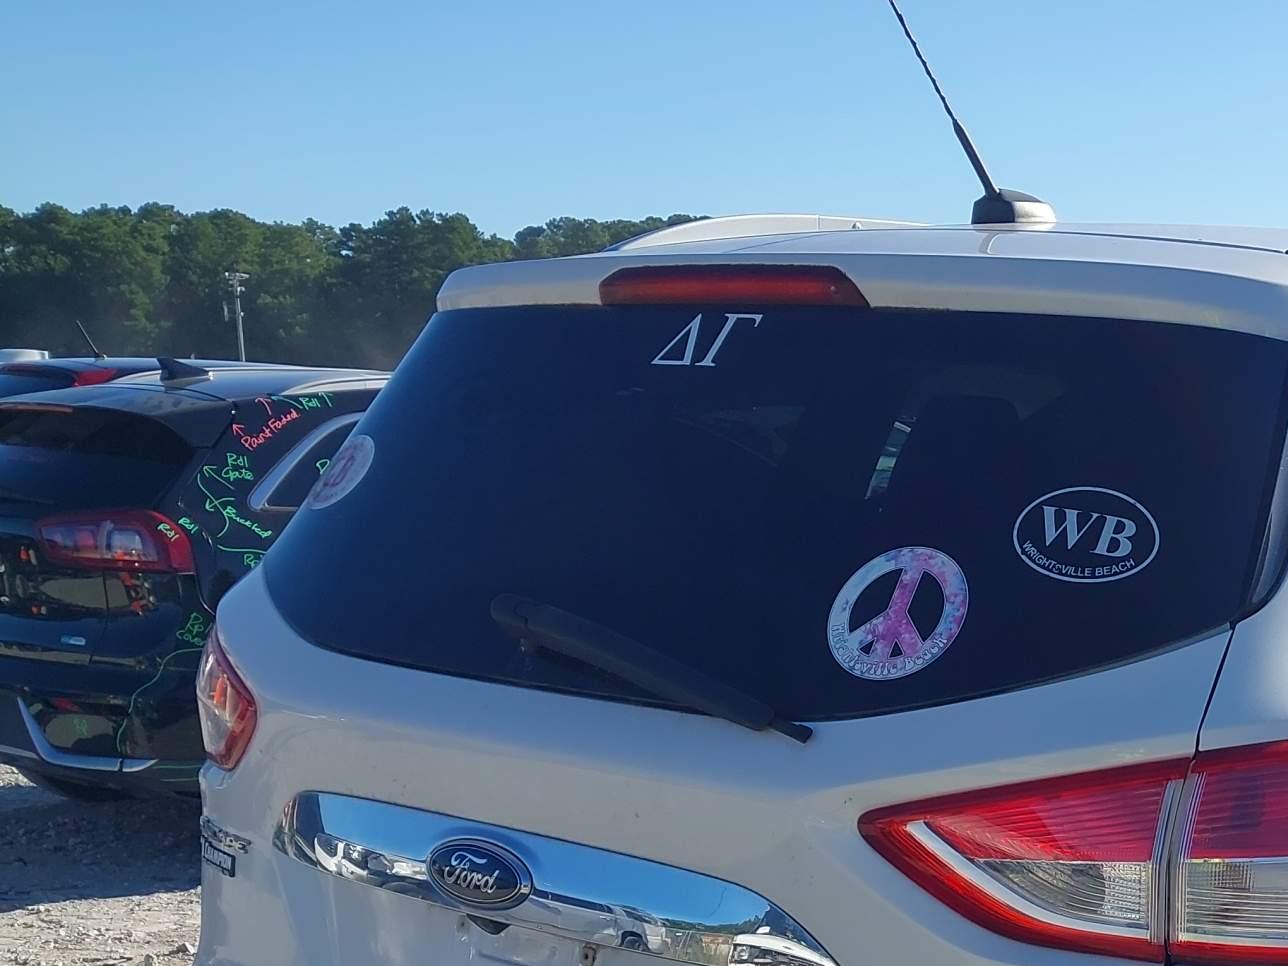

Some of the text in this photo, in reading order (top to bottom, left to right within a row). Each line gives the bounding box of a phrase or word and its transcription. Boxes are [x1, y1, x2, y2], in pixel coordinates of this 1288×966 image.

[650, 312, 764, 367] ΔΓ
[1041, 504, 1137, 558] WB
[1021, 539, 1136, 577] WRIGHTSVILLE BEACH
[443, 850, 500, 894] Ford
